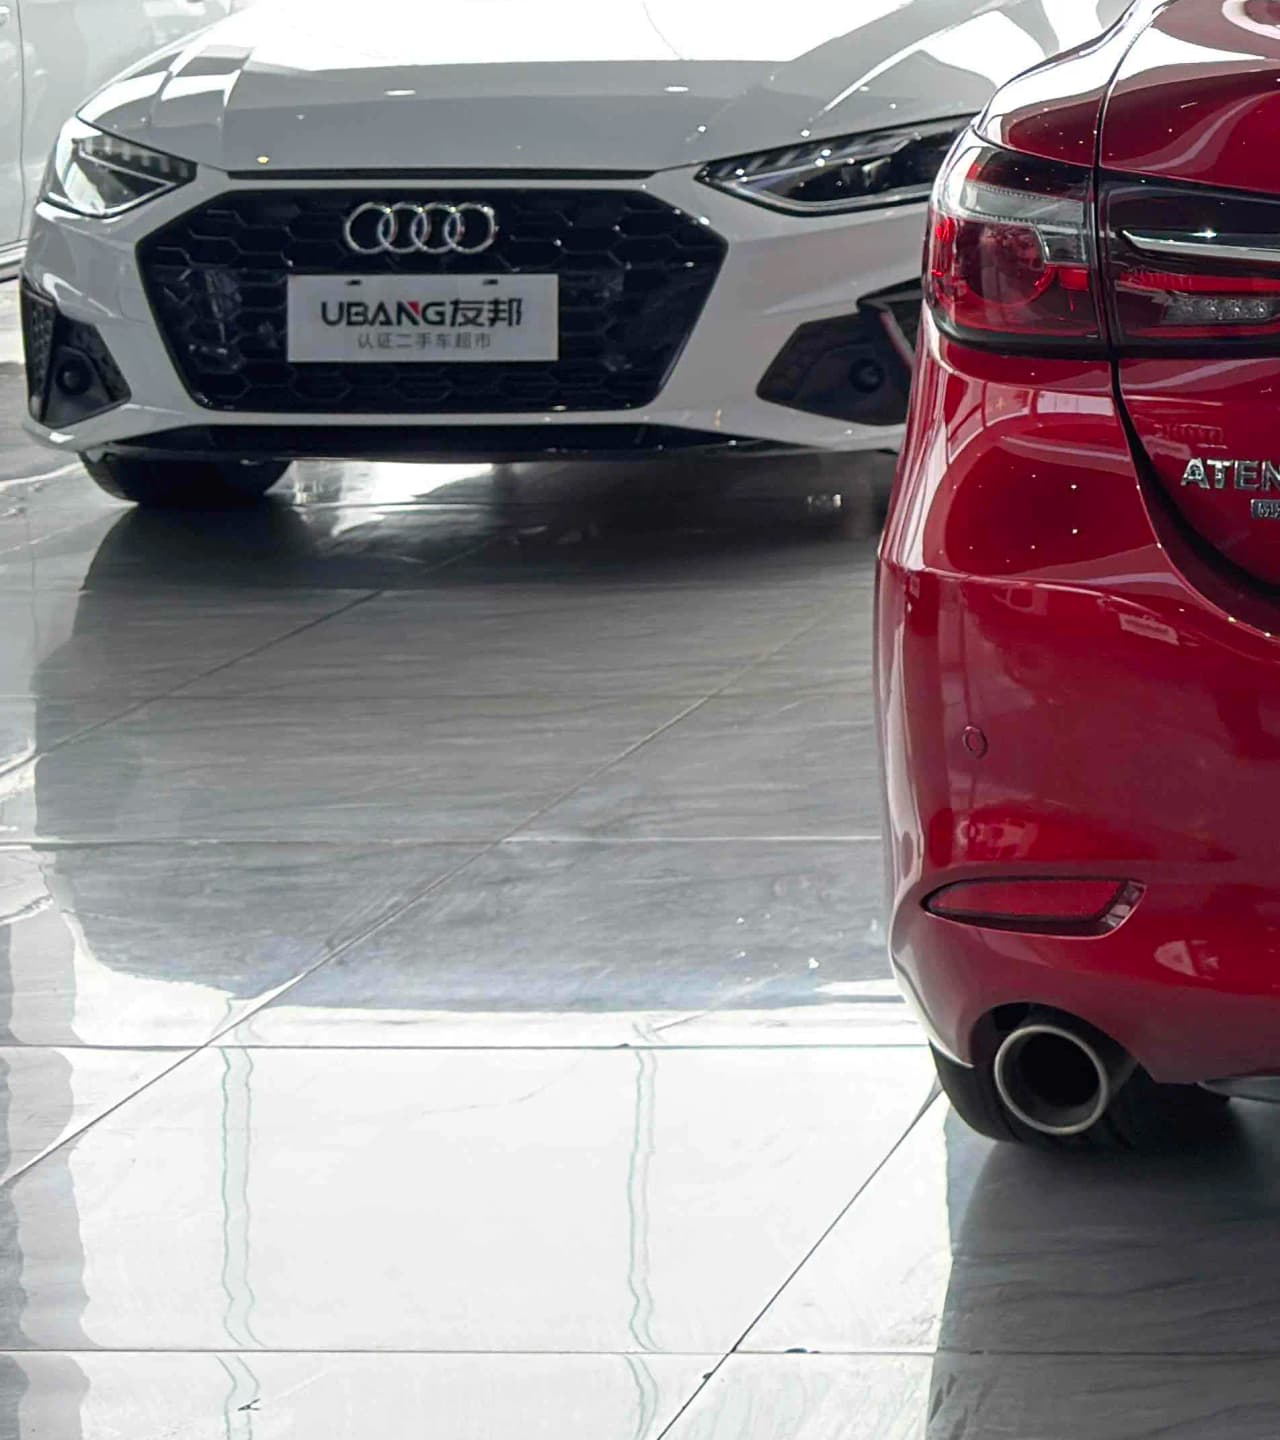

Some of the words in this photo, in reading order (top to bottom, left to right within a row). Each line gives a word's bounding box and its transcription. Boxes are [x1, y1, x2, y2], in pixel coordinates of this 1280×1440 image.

[357, 332, 492, 350] 认证二手车超市
